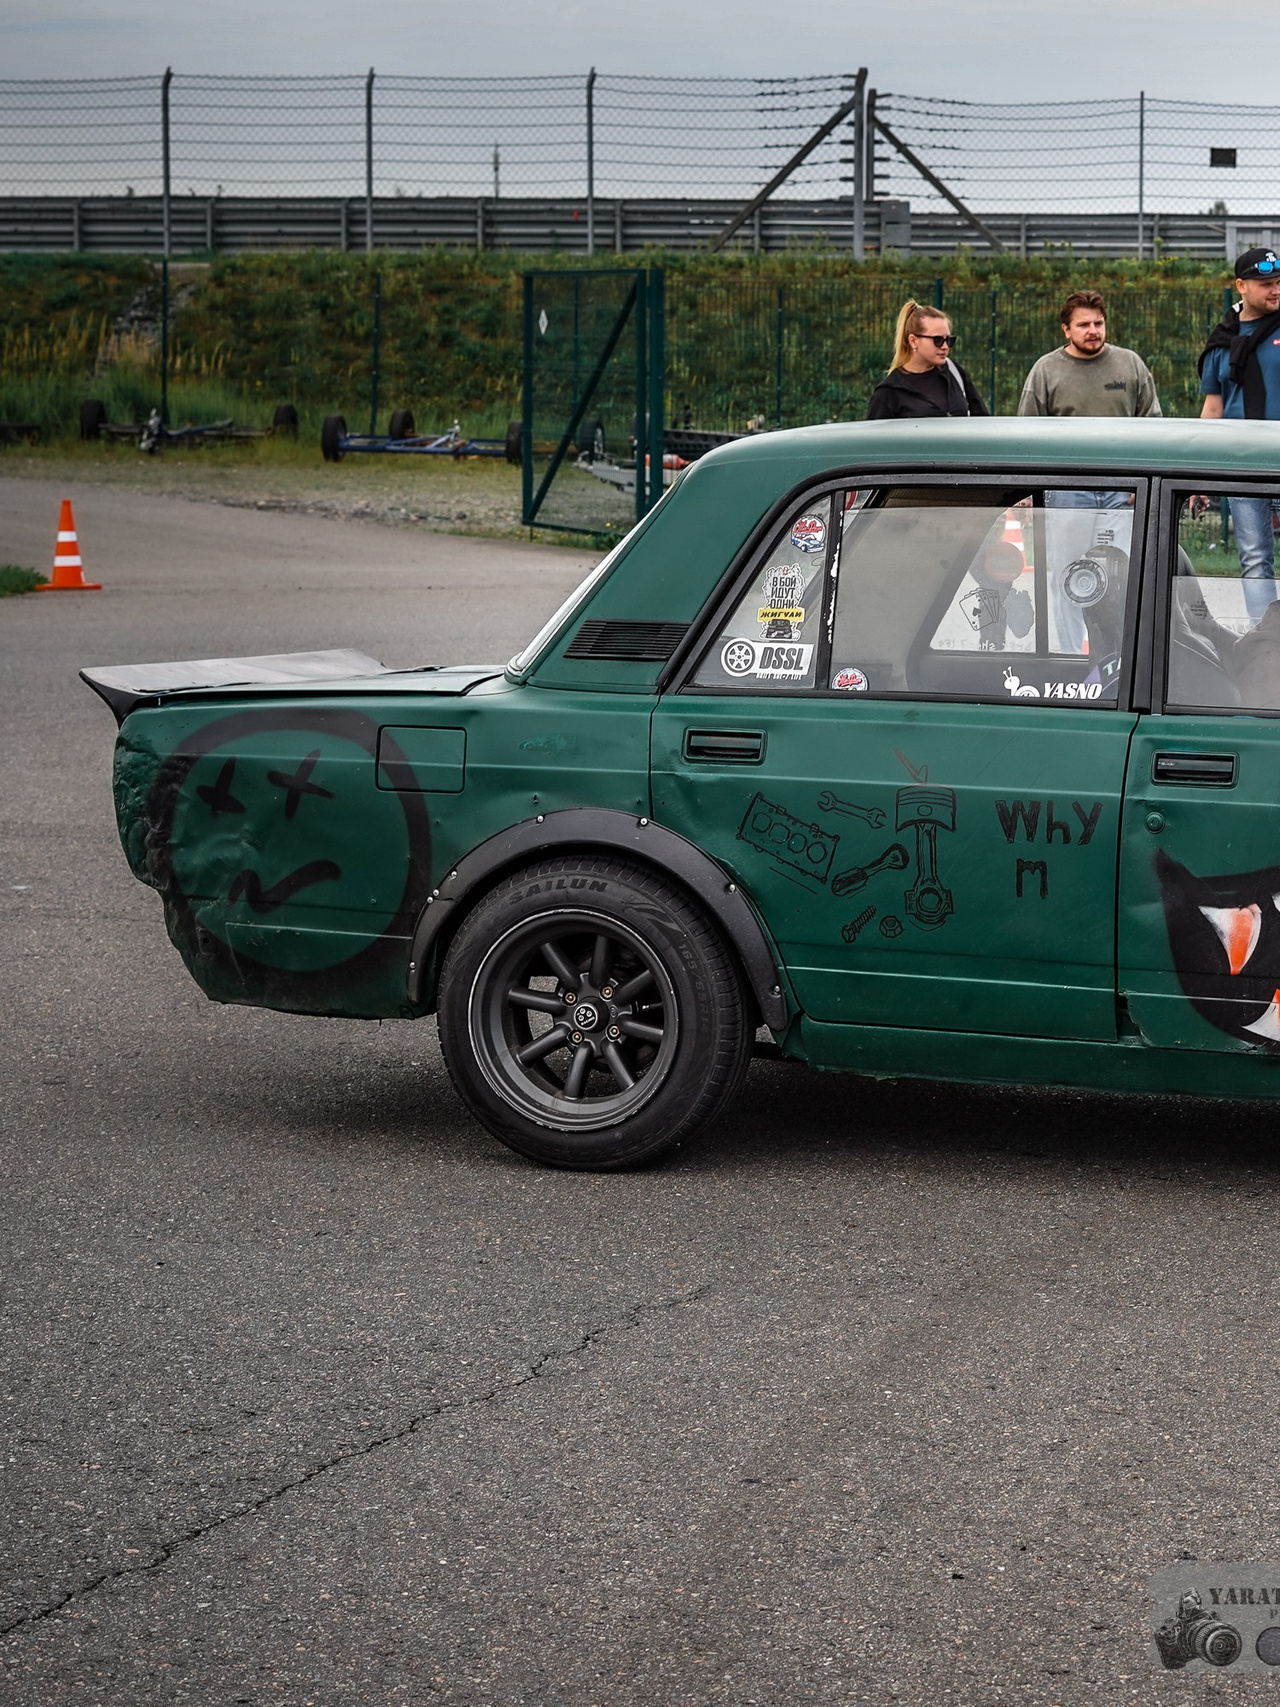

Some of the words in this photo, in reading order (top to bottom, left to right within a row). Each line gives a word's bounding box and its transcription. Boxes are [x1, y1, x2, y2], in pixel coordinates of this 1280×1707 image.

[772, 576, 778, 587] В
[780, 575, 797, 587] БОЙ
[771, 588, 796, 600] ИДУТ
[770, 599, 795, 610] ОДНИ
[759, 646, 805, 671] DSSL
[1043, 682, 1103, 700] YASNO
[508, 878, 609, 906] SAILUN
